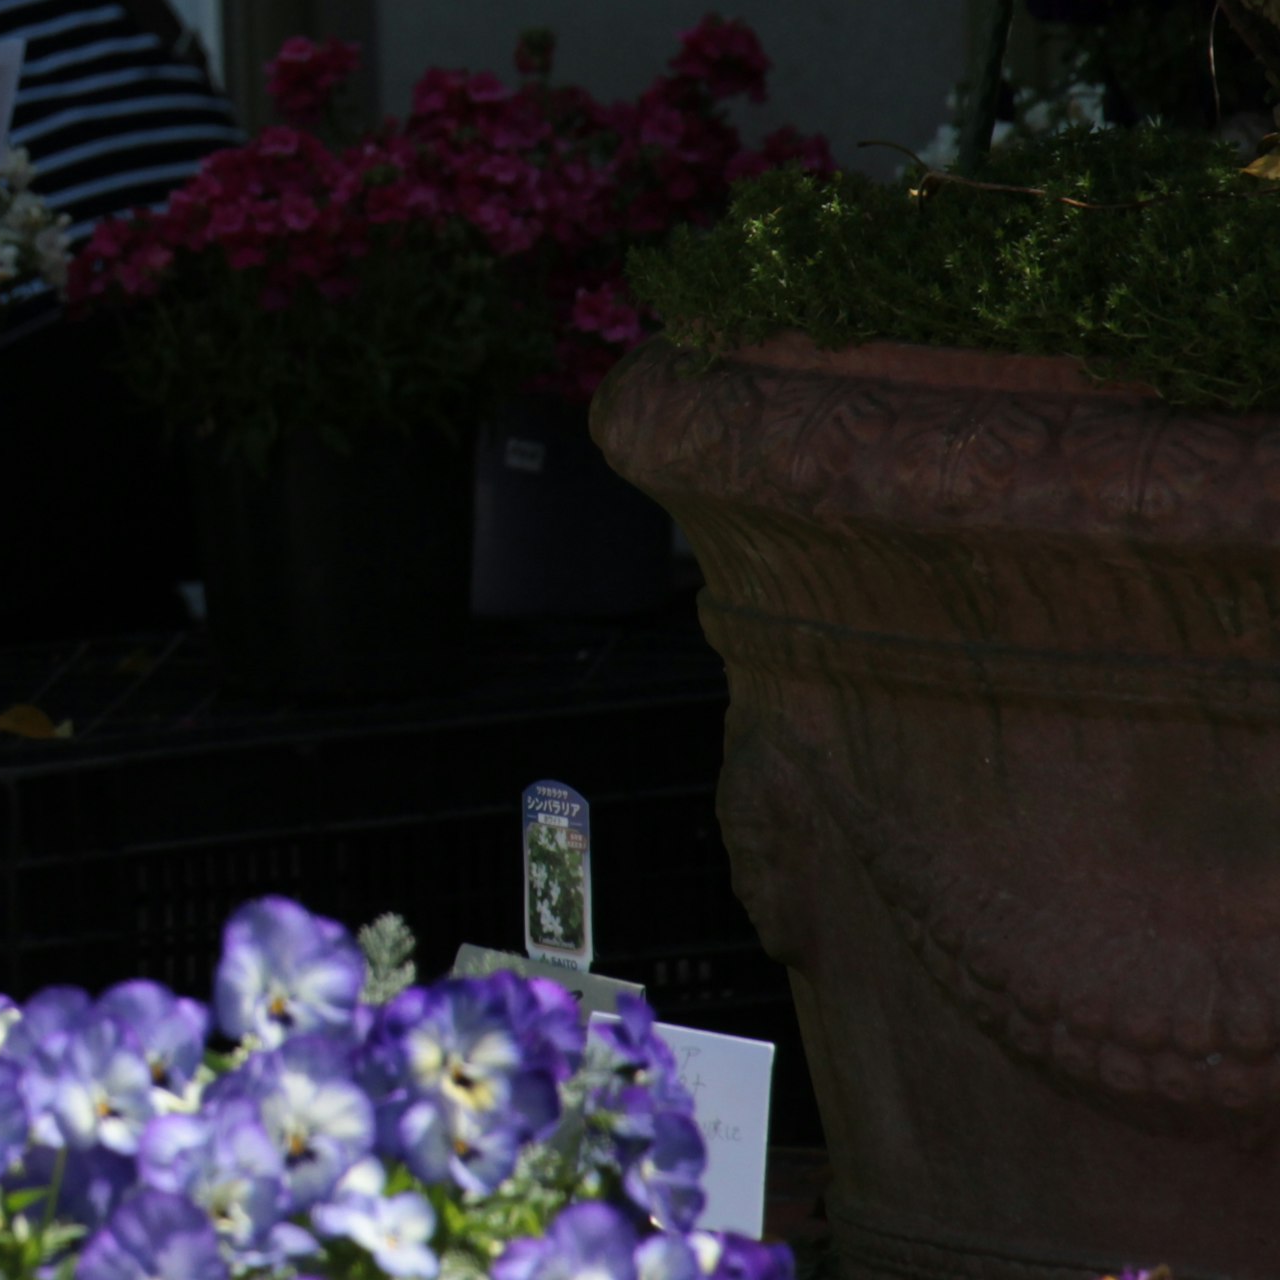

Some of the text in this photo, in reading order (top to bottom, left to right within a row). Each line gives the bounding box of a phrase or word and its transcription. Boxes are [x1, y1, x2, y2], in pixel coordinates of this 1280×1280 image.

[527, 795, 581, 817] シンバラリア
[551, 956, 578, 971] SAITO
